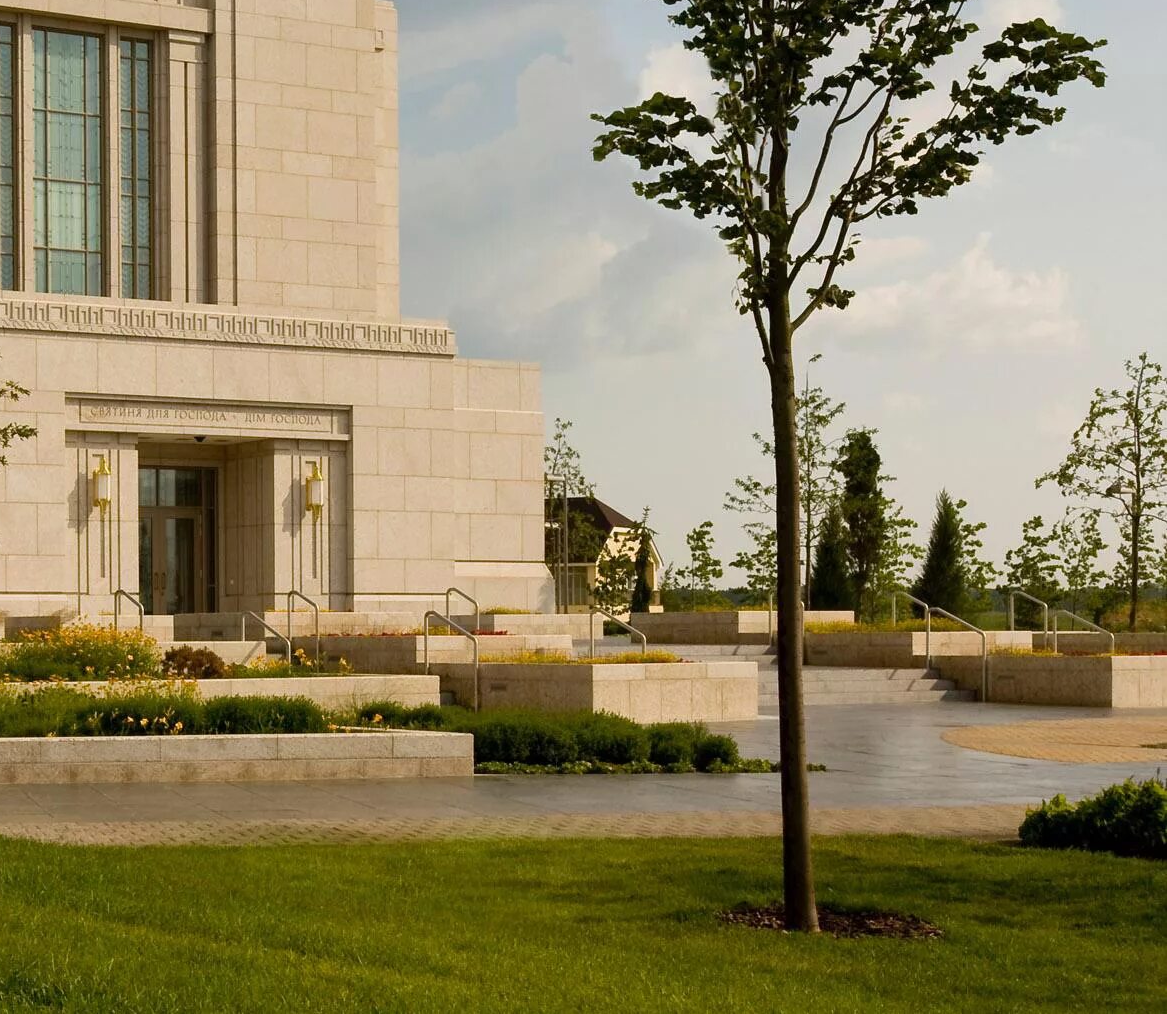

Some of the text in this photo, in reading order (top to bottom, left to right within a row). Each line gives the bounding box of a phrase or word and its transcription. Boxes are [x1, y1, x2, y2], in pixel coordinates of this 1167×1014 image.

[90, 406, 321, 426] СВЯТИНЯ ДЛЯ ГОСПОДА ДІМ ГОСПОДА
